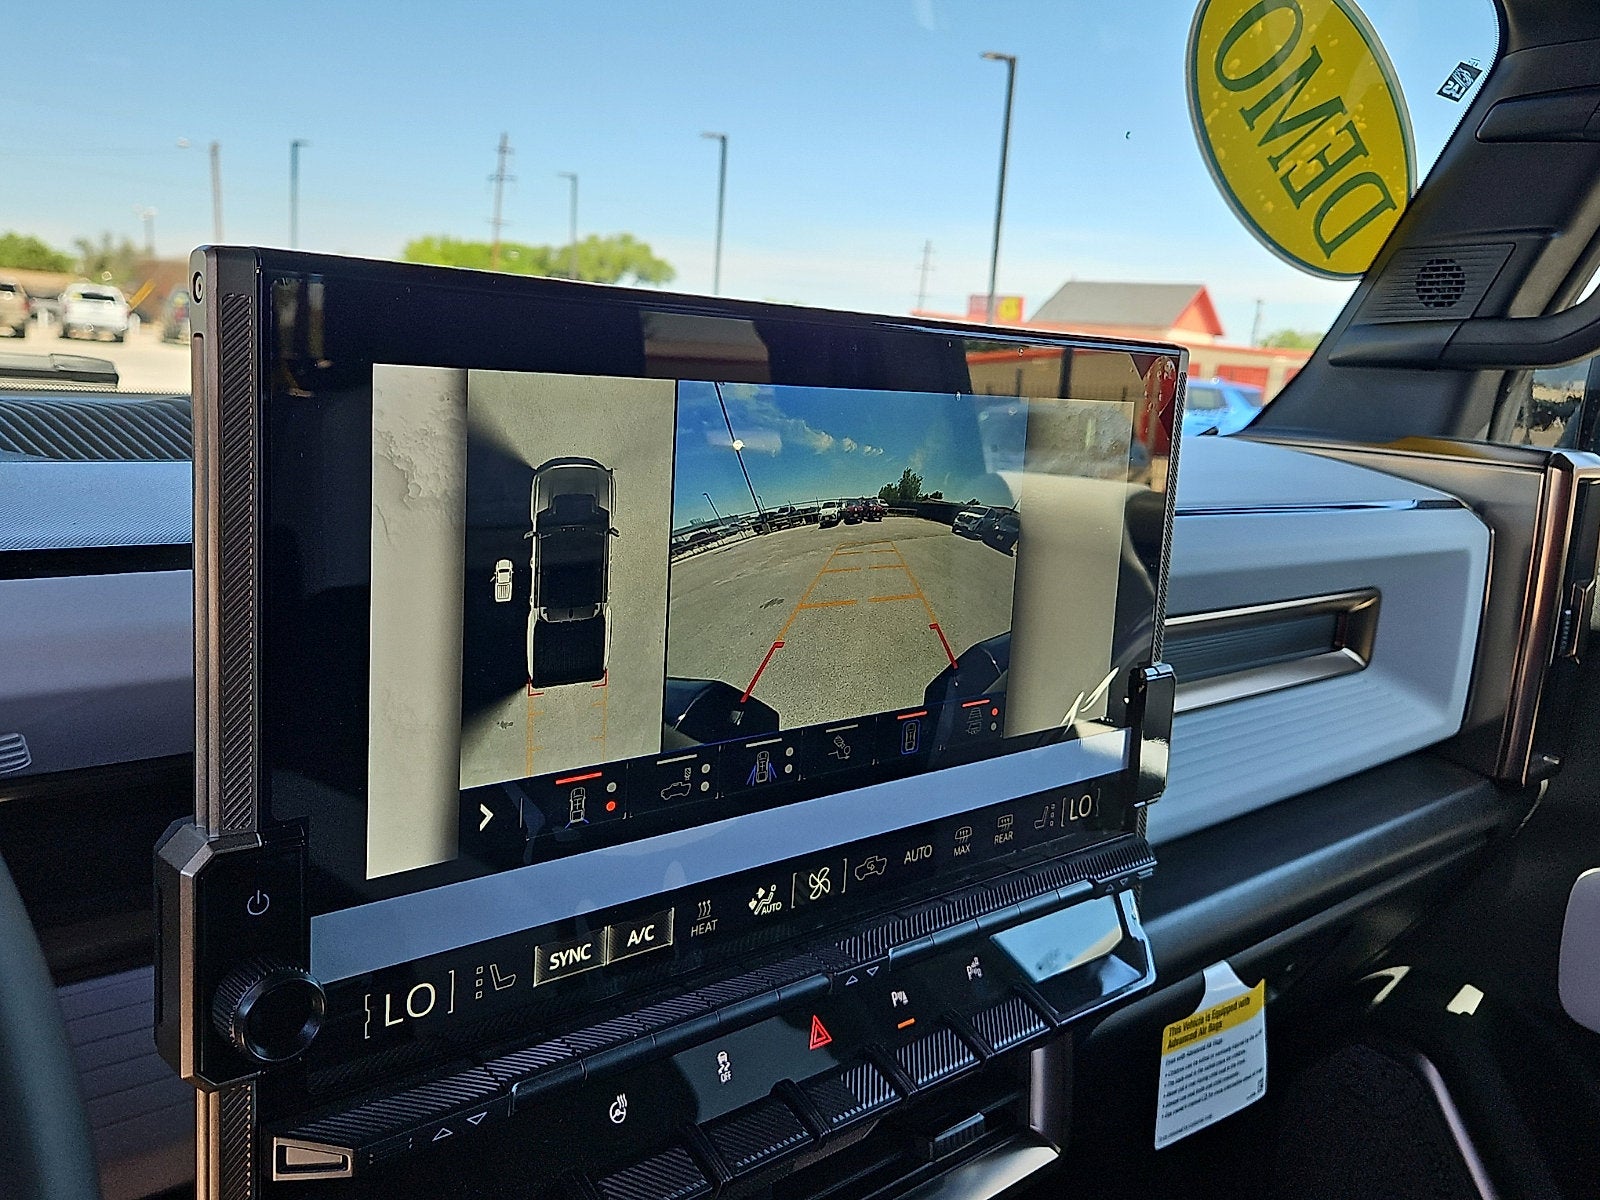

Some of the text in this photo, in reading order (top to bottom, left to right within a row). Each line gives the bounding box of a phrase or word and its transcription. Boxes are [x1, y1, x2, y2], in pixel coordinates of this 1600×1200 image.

[1069, 795, 1092, 821] LO
[994, 831, 1014, 845] REAR
[903, 844, 933, 865] AUTO
[953, 843, 971, 857] MAX
[760, 901, 782, 916] AUTO
[690, 919, 719, 938] HEAT
[549, 924, 655, 971] SYNC A/C
[384, 982, 436, 1027] LO
[1168, 1025, 1182, 1037] This
[1211, 1001, 1238, 1019] Equipped
[1198, 1026, 1207, 1037] Air
[720, 1070, 732, 1083] OFF
